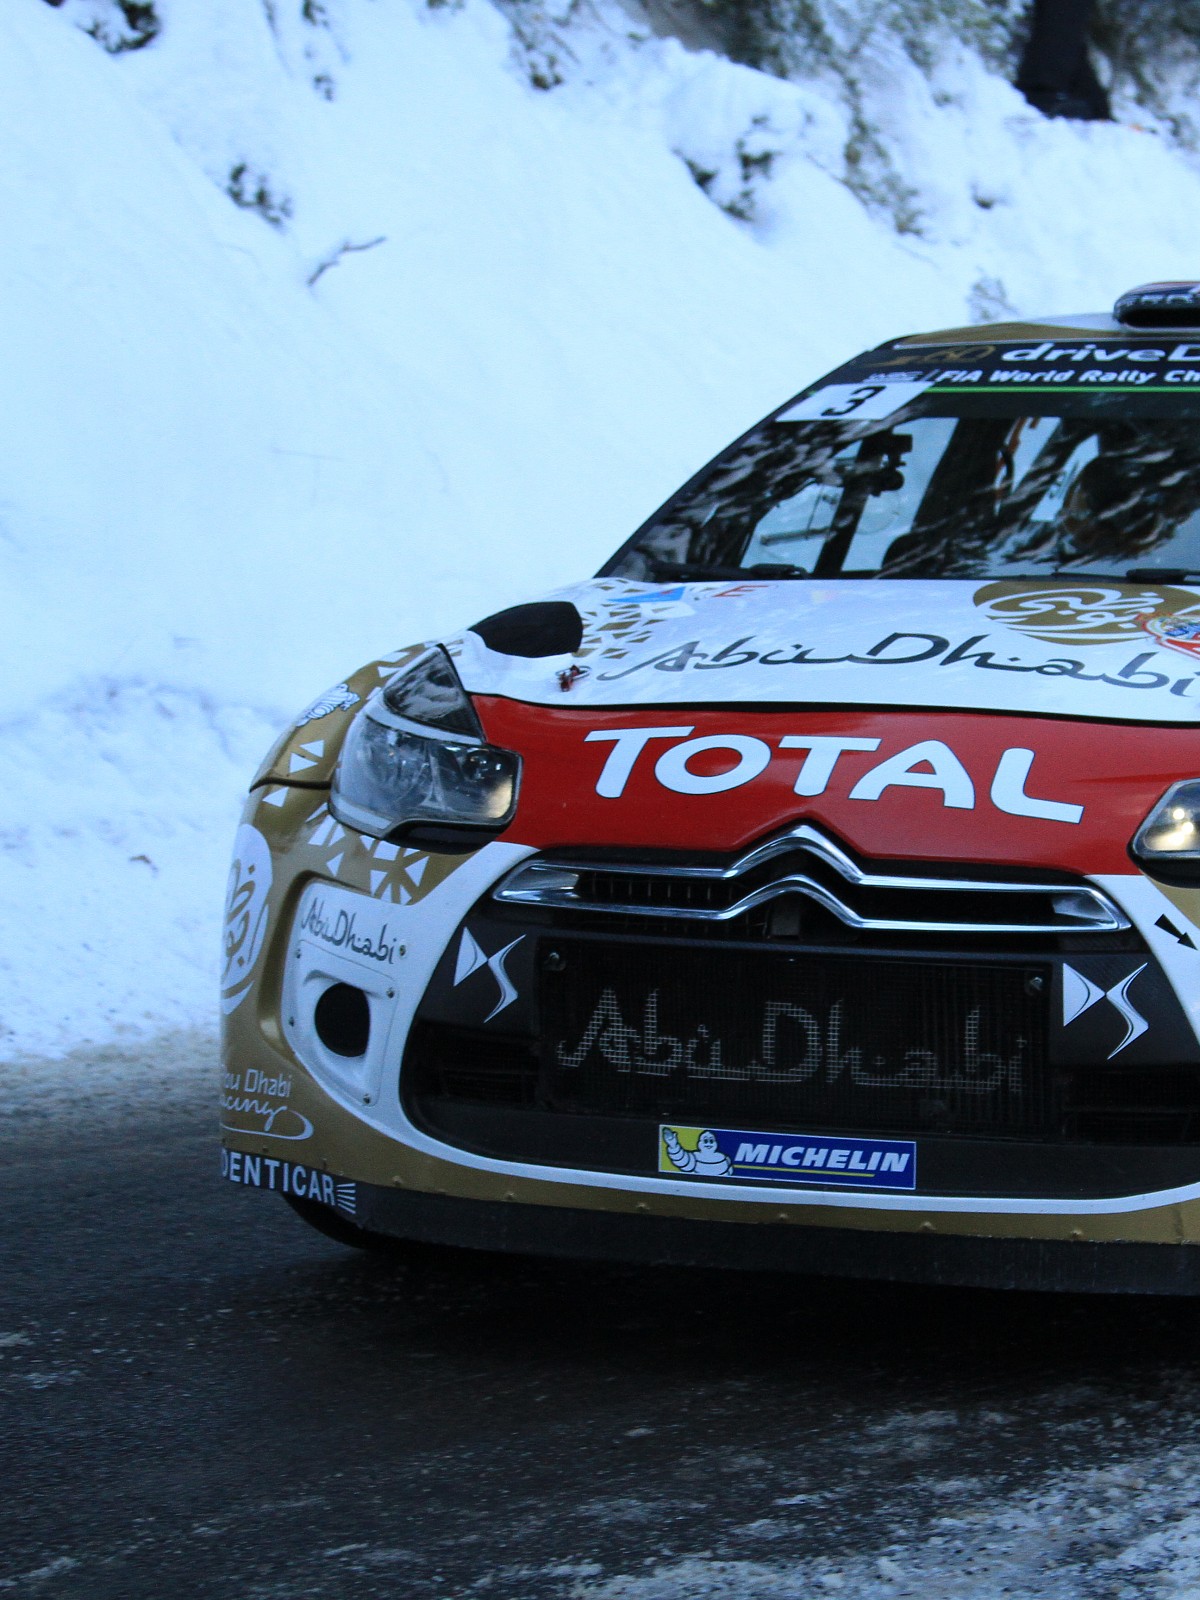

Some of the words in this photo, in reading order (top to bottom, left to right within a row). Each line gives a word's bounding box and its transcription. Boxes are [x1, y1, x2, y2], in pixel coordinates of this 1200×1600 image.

[935, 369, 983, 383] FIA
[989, 369, 1075, 383] World
[1079, 368, 1156, 384] Rally
[820, 385, 887, 416] 3
[584, 725, 1085, 825] TOTAL
[244, 1068, 293, 1098] Dhabi
[733, 1141, 911, 1174] MICHELIN
